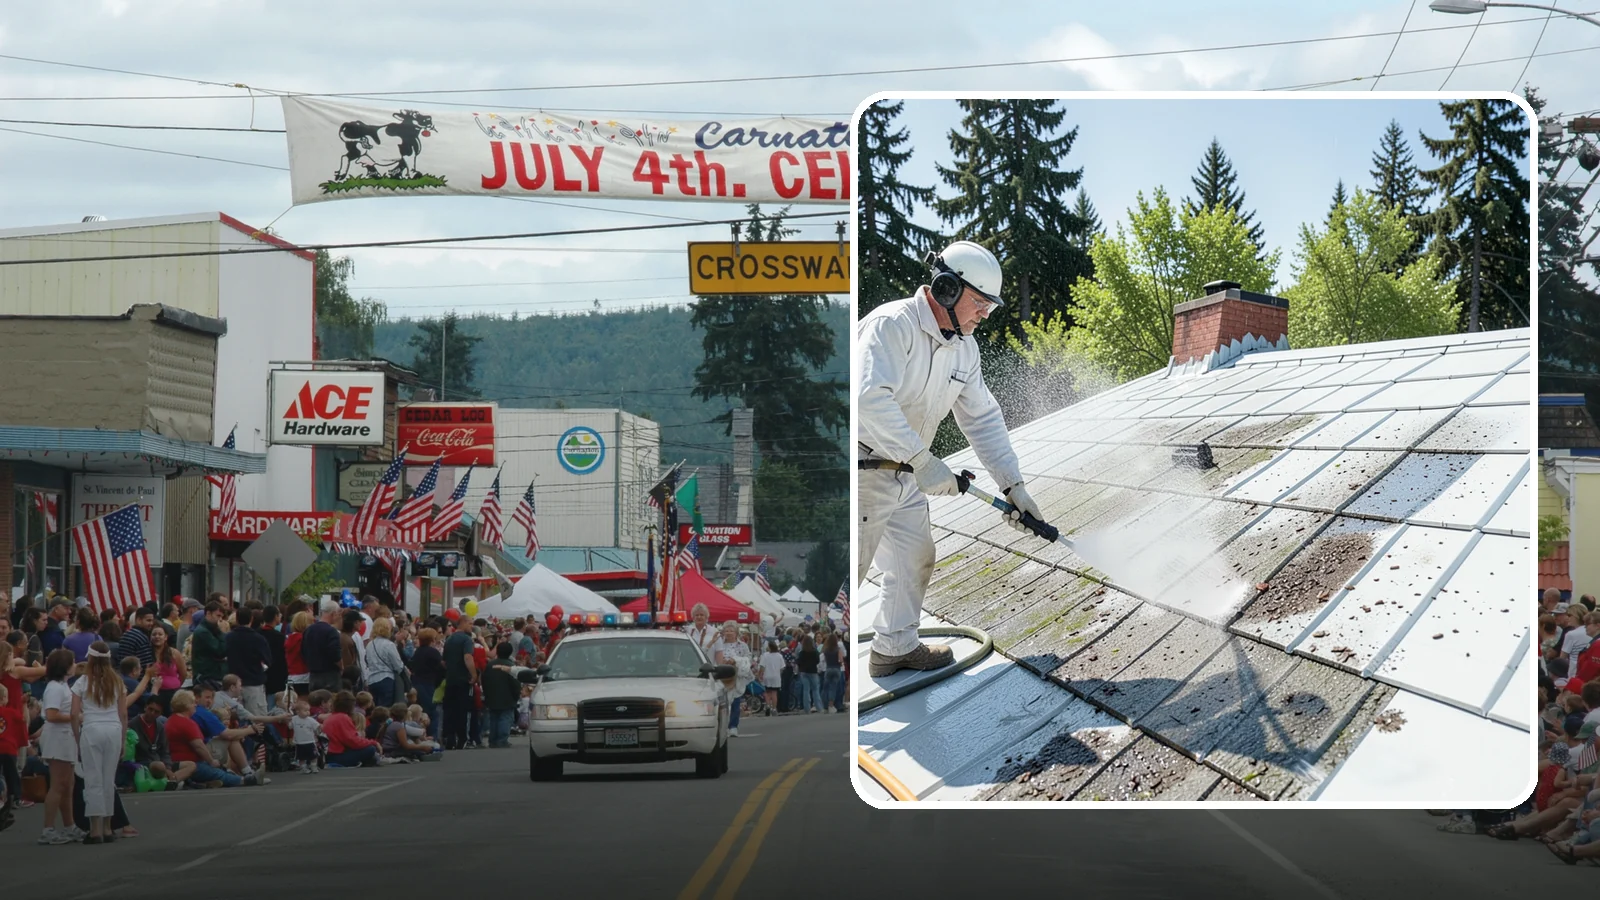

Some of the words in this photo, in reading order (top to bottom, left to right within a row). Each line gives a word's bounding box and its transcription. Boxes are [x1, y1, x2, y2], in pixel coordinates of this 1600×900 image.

[481, 141, 605, 193] JULY
[632, 150, 747, 198] 4th.
[697, 254, 850, 280] CROSSWA
[283, 380, 374, 420] ACE
[405, 409, 452, 421] CEDAR
[283, 421, 370, 437] Hardware
[416, 428, 477, 447] Coca-Cola
[353, 467, 386, 481] Simpl
[83, 485, 93, 494] St.
[96, 485, 124, 494] Vincent
[126, 486, 136, 495] de
[138, 486, 155, 496] Paul
[688, 526, 741, 535] CRNATION
[699, 535, 730, 543] GLASS
